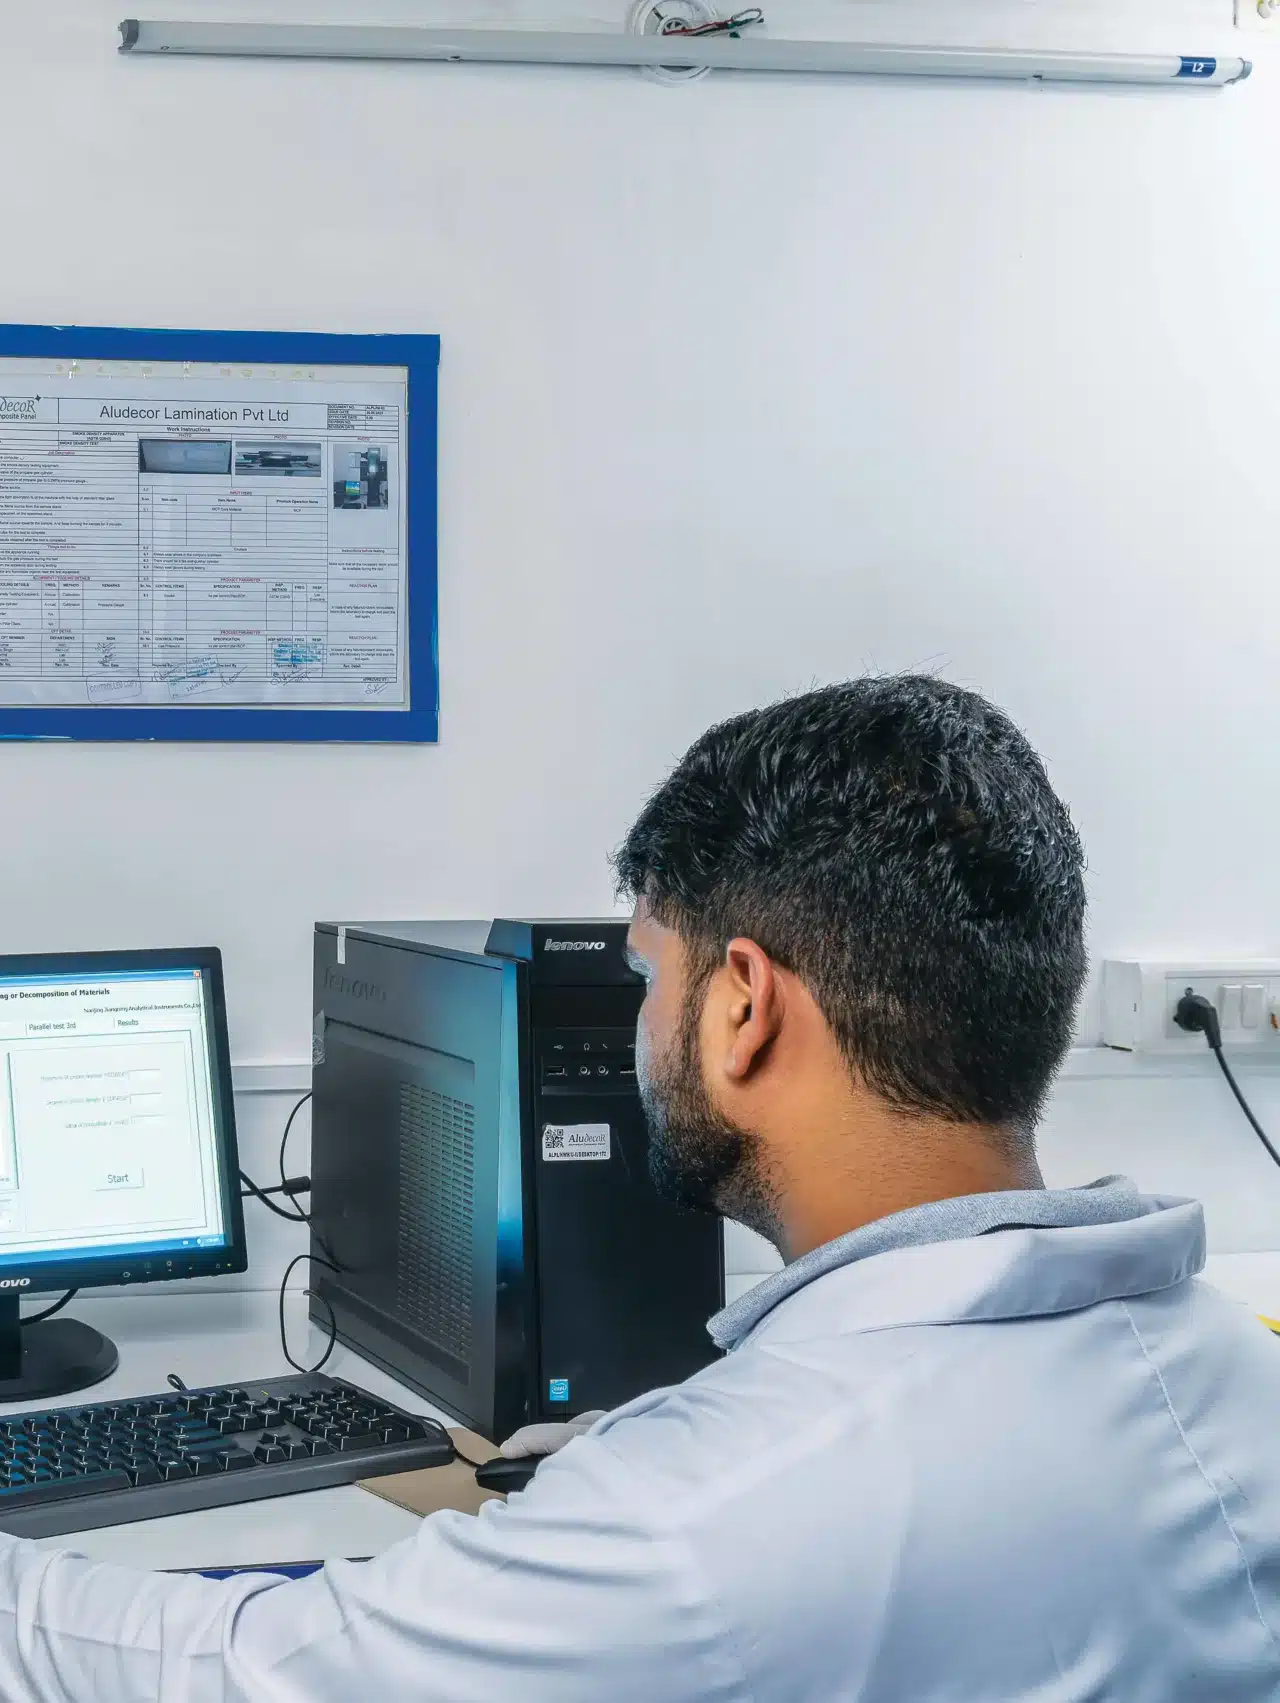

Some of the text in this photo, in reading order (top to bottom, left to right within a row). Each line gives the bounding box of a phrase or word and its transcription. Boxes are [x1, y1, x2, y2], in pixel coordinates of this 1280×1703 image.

[99, 405, 290, 422] Aludecor Lamination Pvt Ltd
[543, 938, 606, 952] lenovo
[19, 990, 69, 1000] Decomposition
[70, 989, 78, 997] of
[79, 988, 111, 996] Materials
[28, 1023, 52, 1031] Parallel
[66, 1021, 77, 1030] 3rd
[117, 1019, 139, 1027] Results
[107, 1173, 129, 1184] Start
